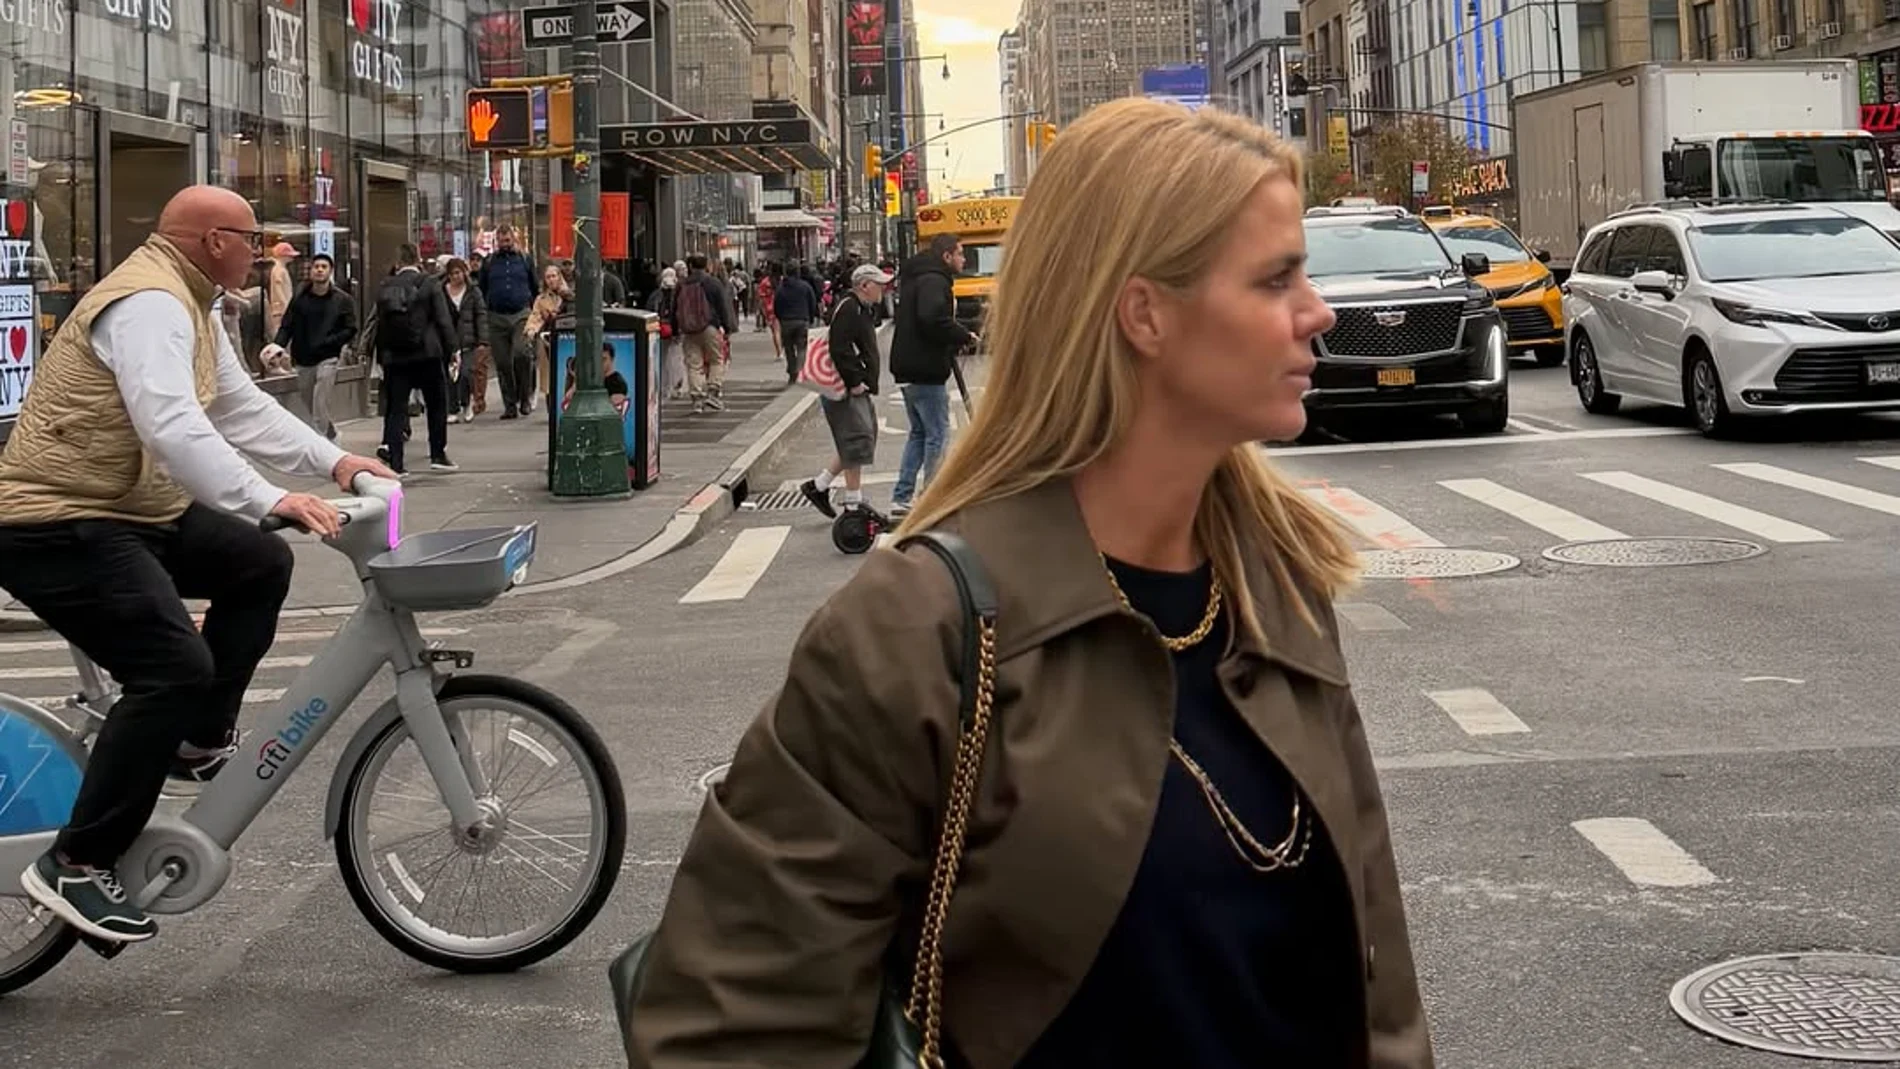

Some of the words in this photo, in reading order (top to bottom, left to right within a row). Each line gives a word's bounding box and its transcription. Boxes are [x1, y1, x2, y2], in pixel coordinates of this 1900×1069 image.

[267, 5, 302, 66] NY
[595, 13, 632, 31] WAY
[268, 65, 303, 99] GIFTS
[353, 40, 402, 91] GIFTS
[621, 128, 694, 147] ROW
[712, 125, 778, 143] NYC
[957, 209, 987, 223] SCHOOL
[990, 206, 1008, 220] BUS
[256, 739, 292, 781] citi
[277, 697, 328, 746] bike
